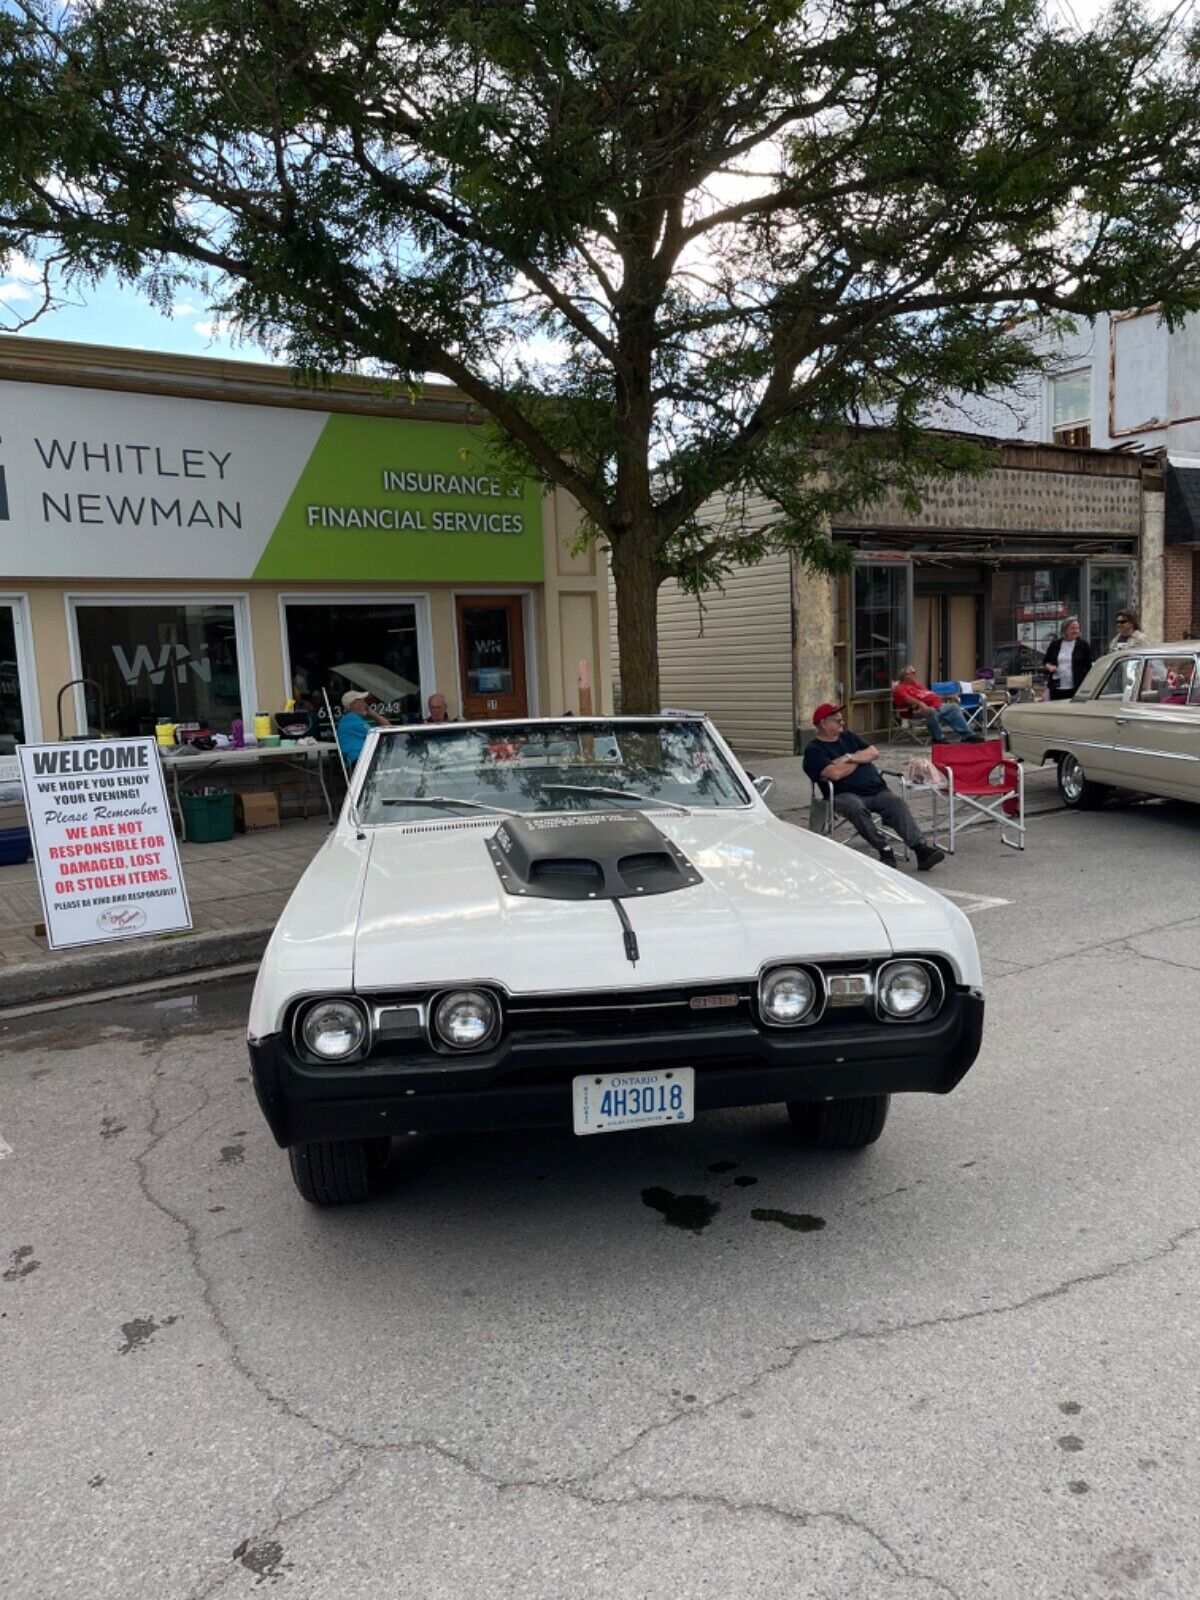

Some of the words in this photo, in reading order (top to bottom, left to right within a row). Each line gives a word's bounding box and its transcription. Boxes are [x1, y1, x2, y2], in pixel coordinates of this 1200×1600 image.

[34, 437, 232, 480] WHITLEY
[383, 470, 501, 497] INSURANCE
[42, 491, 242, 529] NEWMAN
[307, 506, 427, 530] FINANCIAL
[431, 511, 523, 534] SERVICES
[111, 643, 212, 686] WN
[318, 705, 342, 719] 63
[33, 746, 148, 774] WELCOME
[37, 781, 57, 793] WE
[59, 778, 90, 792] HOPE
[91, 776, 116, 789] YOU
[117, 774, 150, 787] ENJOY
[53, 792, 86, 806] YOUR
[88, 788, 141, 803] EVENING!
[44, 810, 89, 825] Please
[93, 802, 158, 820] Remember
[66, 826, 88, 840] WE
[90, 823, 116, 837] ARE
[118, 820, 144, 834] NOT
[49, 839, 138, 859] RESPONSIBLE
[141, 835, 165, 849] FOR
[59, 858, 129, 876] DAMAGED,
[130, 852, 161, 866] LOST
[55, 879, 75, 895] OR
[76, 873, 127, 892] STOLEN
[128, 869, 172, 884] ITEMS.
[54, 899, 81, 911] PLEASE
[82, 898, 91, 907] BE
[93, 896, 111, 906] KIND
[112, 894, 127, 904] AND
[128, 887, 176, 900] RESPONSIBLE!
[611, 1075, 658, 1088] ONTARIO
[600, 1084, 682, 1116] 4H3018
